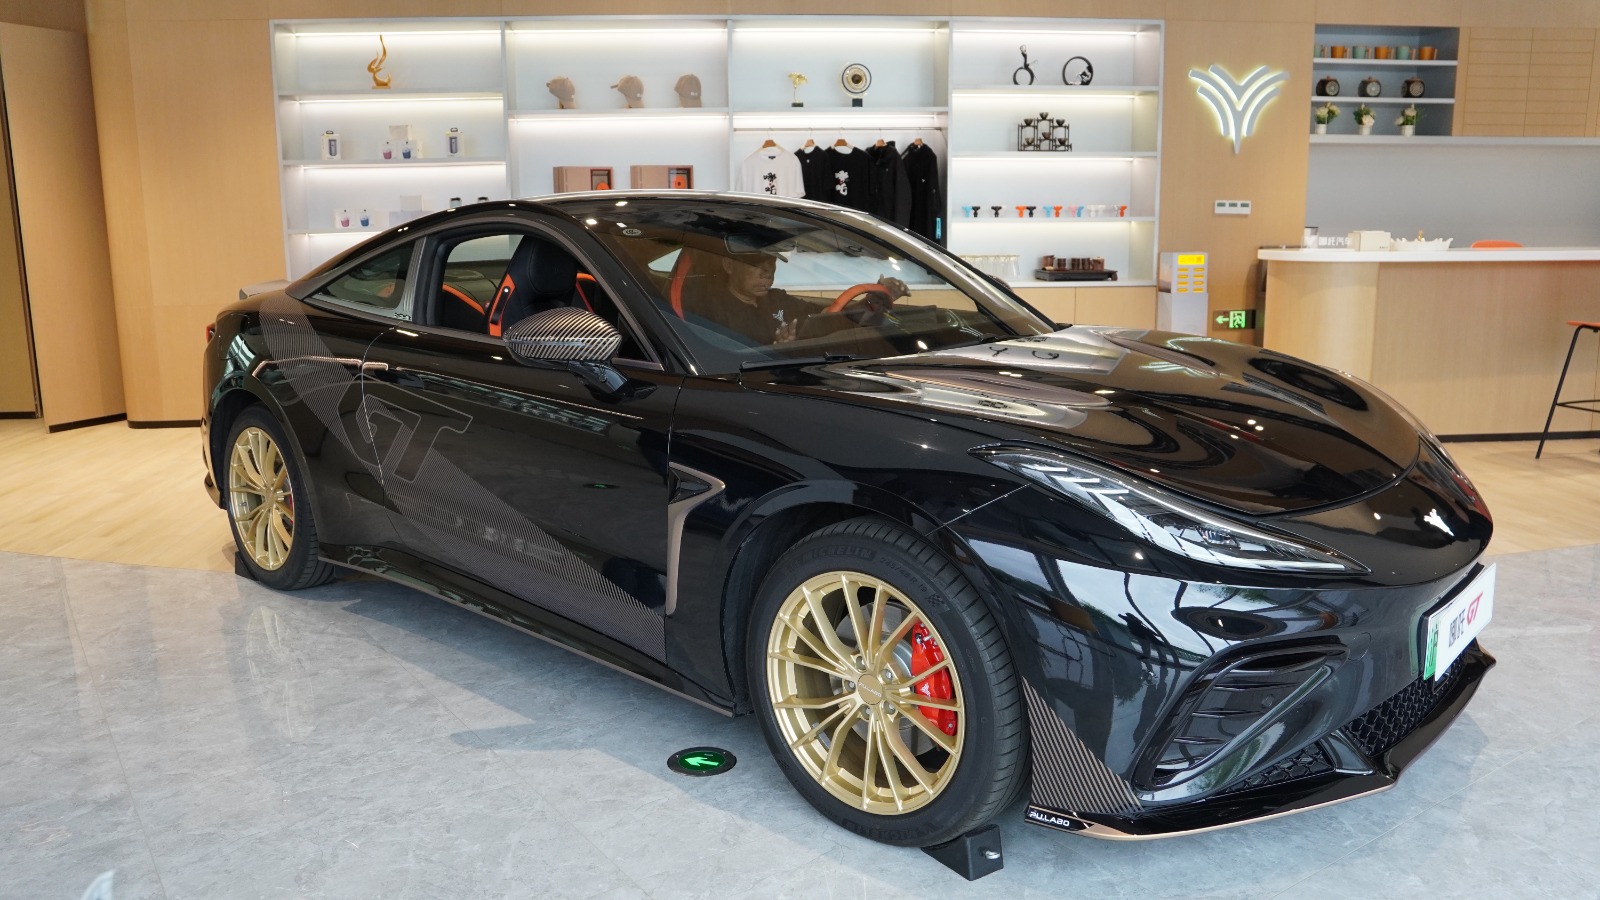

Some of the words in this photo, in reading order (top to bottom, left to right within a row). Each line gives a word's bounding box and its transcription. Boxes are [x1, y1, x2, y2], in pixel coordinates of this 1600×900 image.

[338, 373, 474, 483] GT
[1467, 592, 1484, 625] GT
[1029, 811, 1070, 827] PU.LABO
